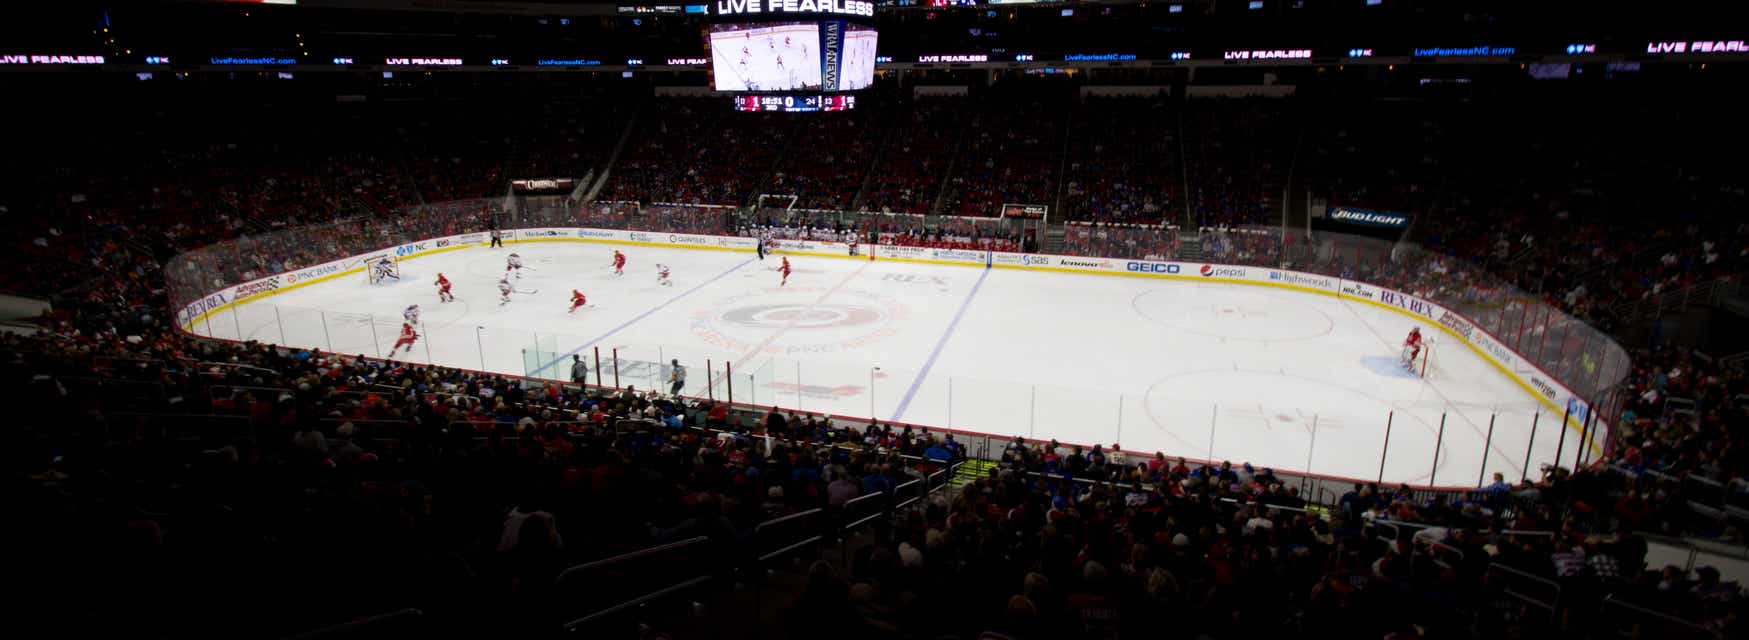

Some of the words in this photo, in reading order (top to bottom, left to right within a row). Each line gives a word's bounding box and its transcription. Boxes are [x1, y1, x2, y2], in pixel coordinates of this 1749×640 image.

[718, 0, 761, 14] LIVE
[768, 0, 874, 16] FEARLESS
[1414, 46, 1515, 57] LiveFearlessNC.com
[1647, 41, 1687, 53] LIVE
[31, 55, 105, 64] FEARLESS
[1064, 53, 1136, 62] LiveFearlessNC.com
[1224, 51, 1249, 59] LIVE
[1252, 50, 1312, 59] FEARLESS
[211, 57, 296, 65] LiveFearlessNC.com
[753, 96, 759, 107] 1
[785, 96, 793, 107] 0
[1337, 210, 1365, 220] BUD
[1365, 213, 1406, 225] LIGHT
[415, 243, 427, 251] NC
[1031, 256, 1049, 265] sas
[1060, 258, 1098, 268] lenovo
[1127, 261, 1180, 274] GEICO
[1215, 268, 1246, 277] pepsi
[296, 270, 316, 281] PNC
[1278, 270, 1333, 288] Highwoods
[206, 293, 227, 310] REX
[1380, 290, 1407, 308] REX
[1409, 299, 1433, 318] REX
[1530, 376, 1556, 399] verizon
